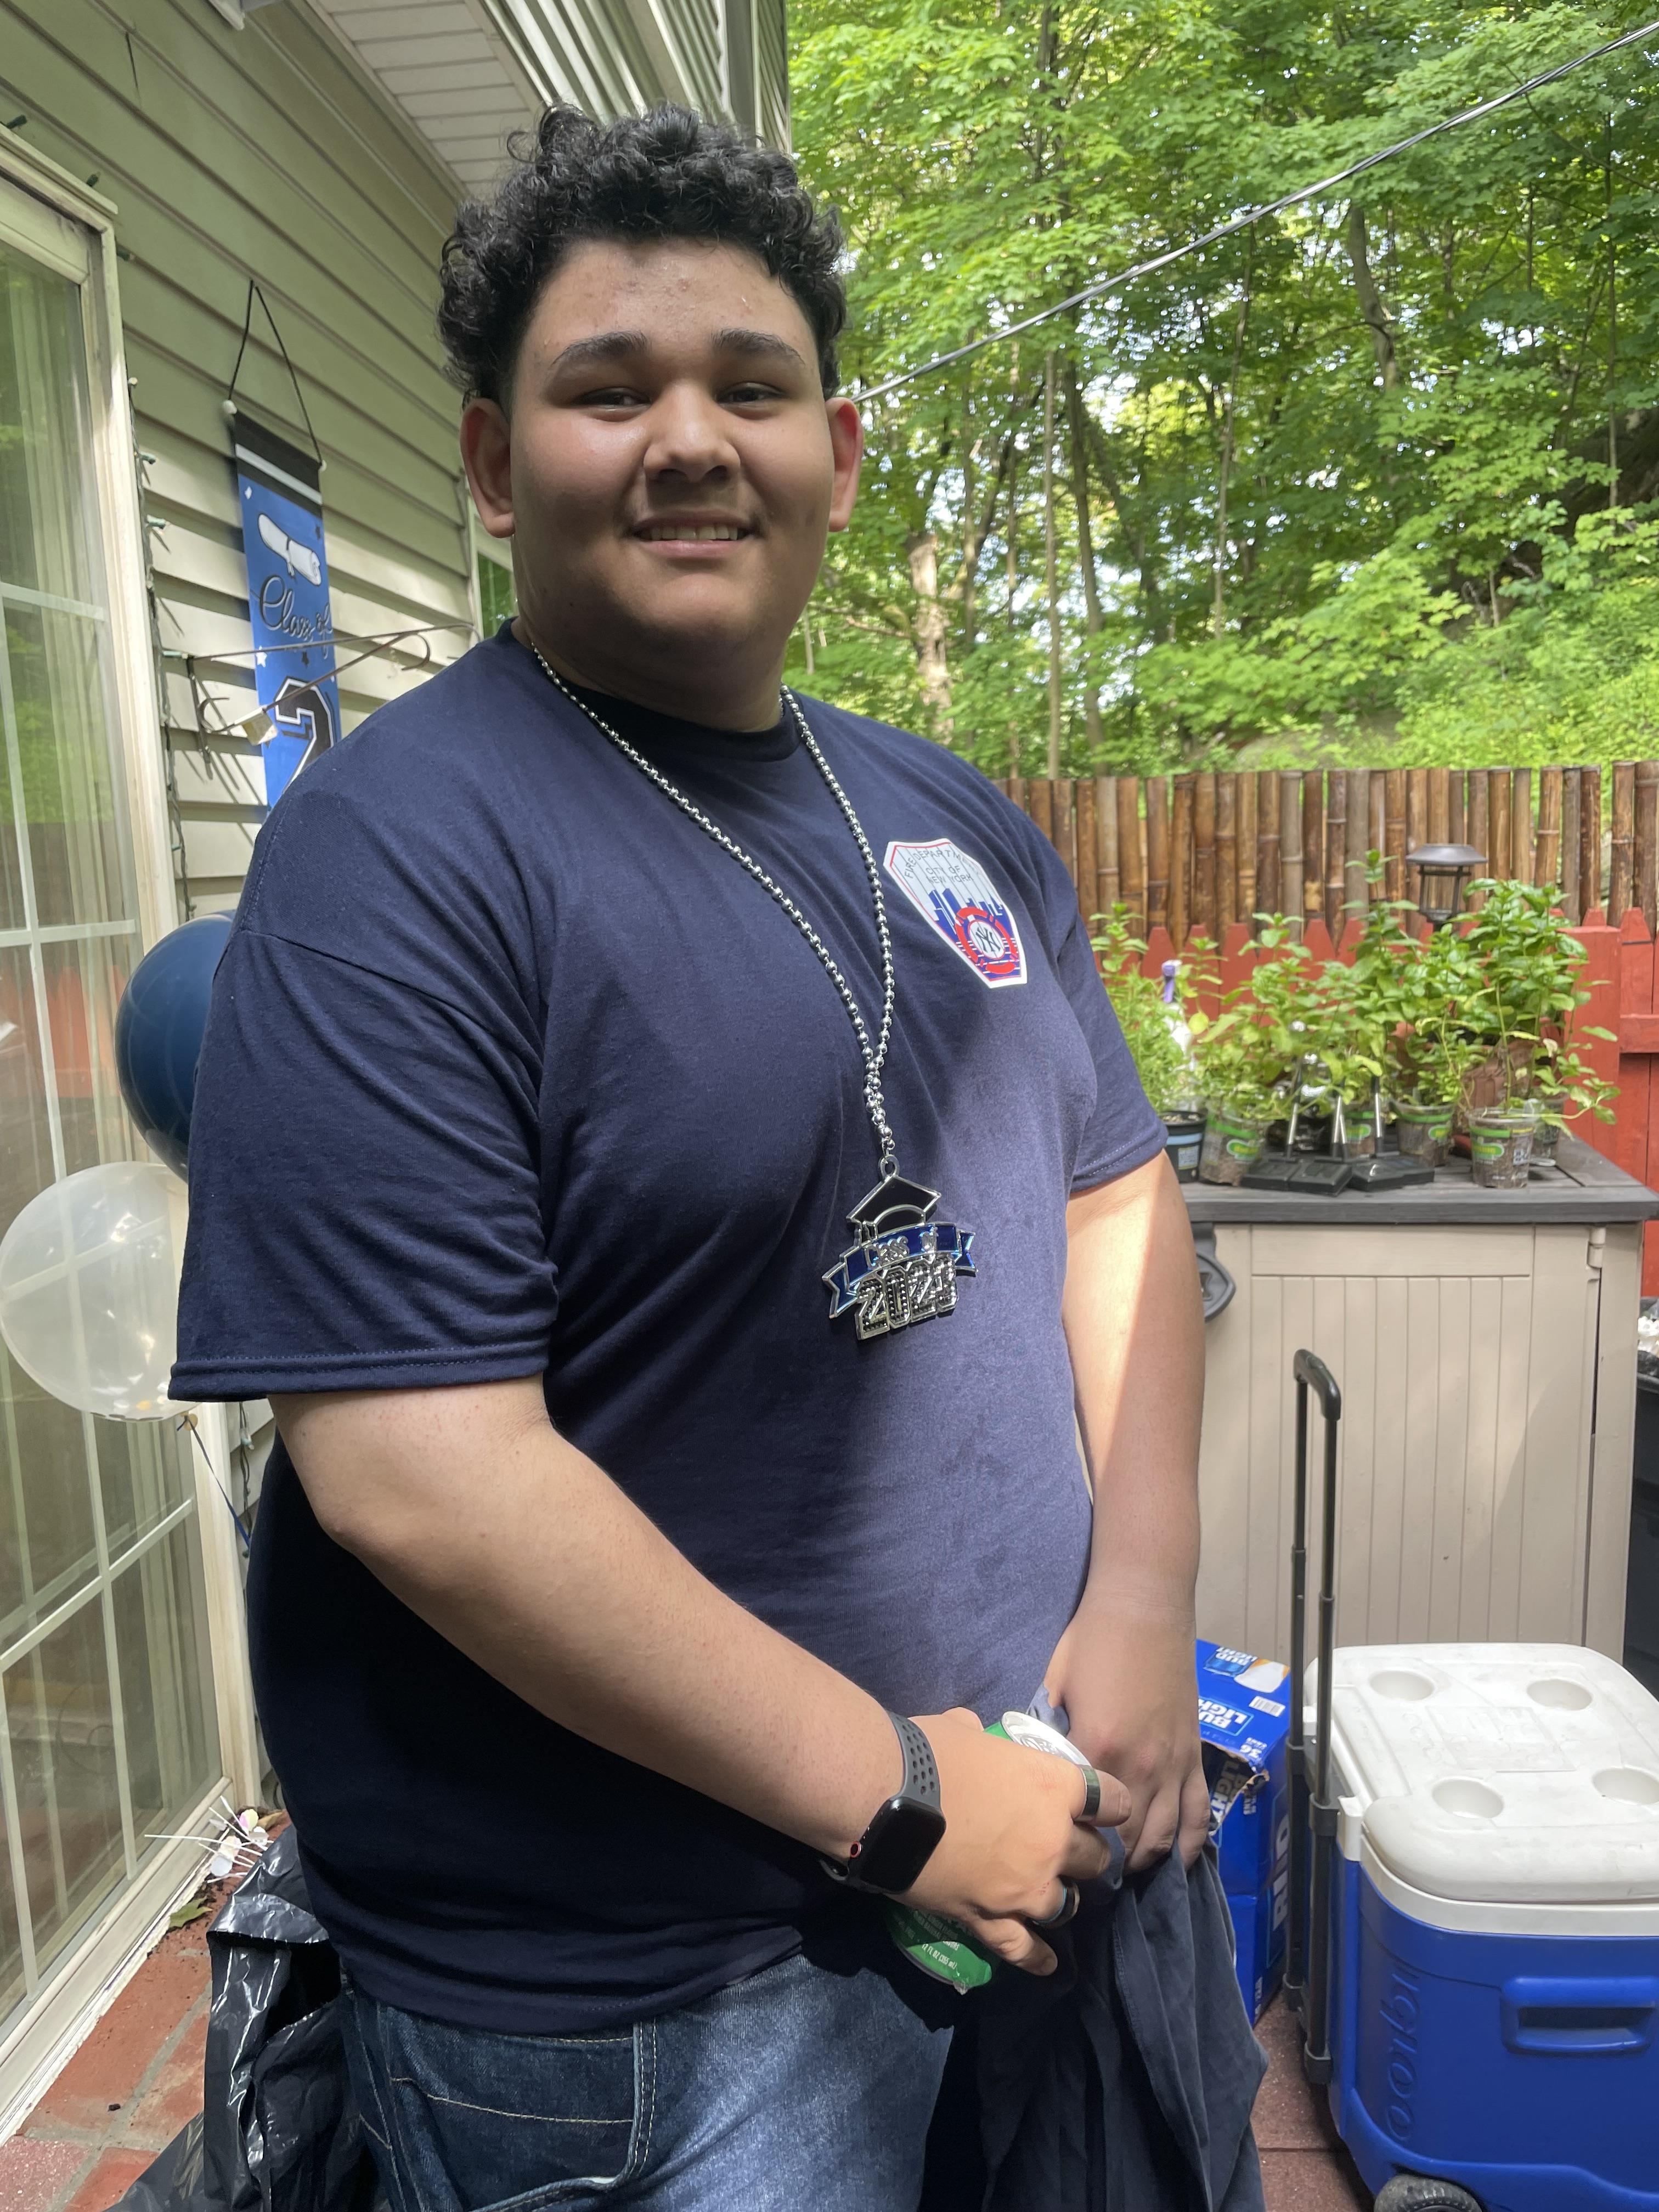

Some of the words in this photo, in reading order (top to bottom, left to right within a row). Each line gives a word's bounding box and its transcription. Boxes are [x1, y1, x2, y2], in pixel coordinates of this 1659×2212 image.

[259, 575, 316, 644] Class
[317, 603, 334, 661] of
[905, 857, 917, 879] FIRE
[926, 867, 944, 876] CITY
[948, 865, 961, 874] OF
[926, 875, 946, 884] NEW
[949, 873, 974, 883] YORK
[1215, 1652, 1249, 1666] BUD
[1199, 1699, 1247, 1724] LIGH
[1199, 1711, 1232, 1729] BU
